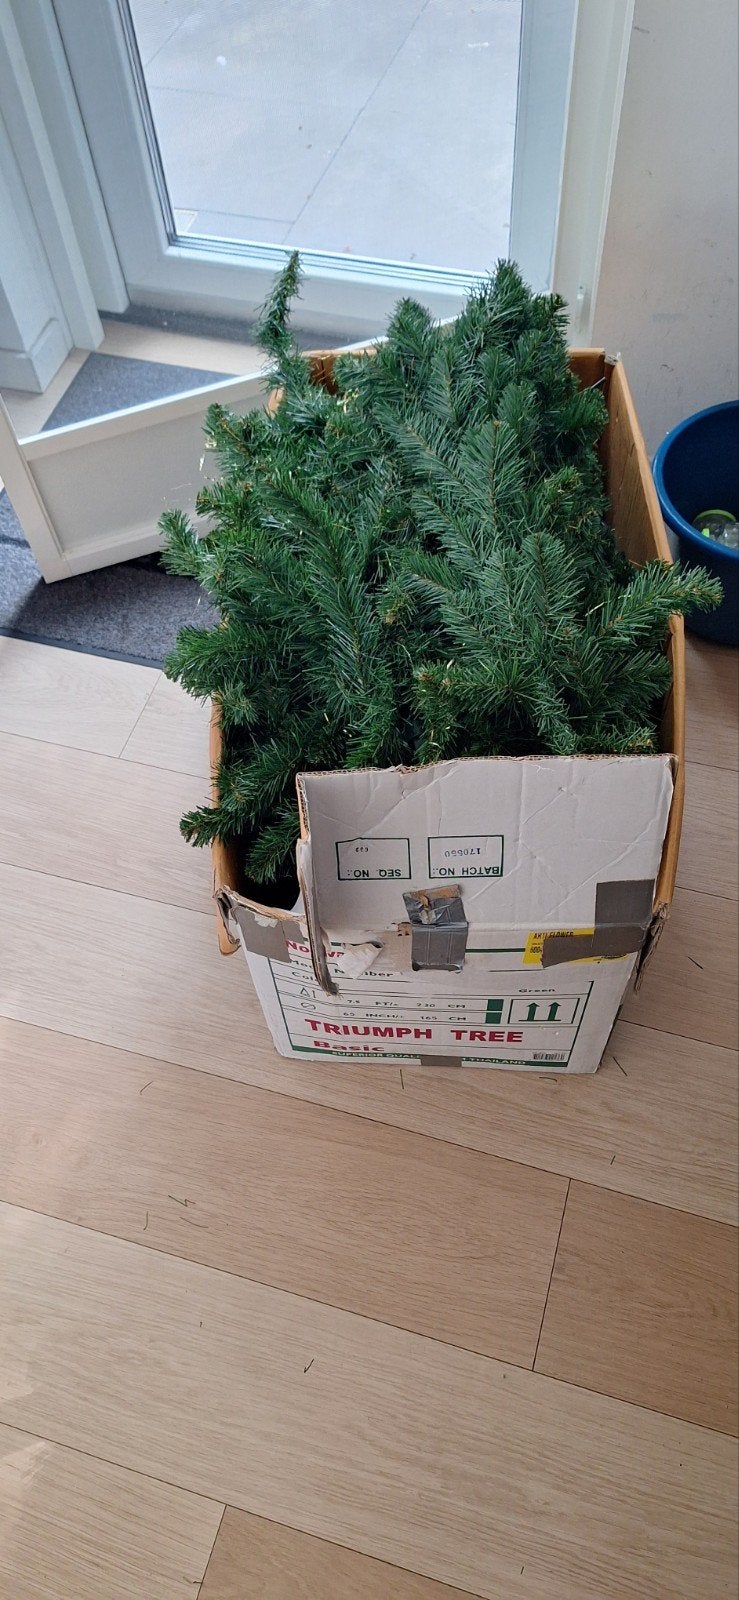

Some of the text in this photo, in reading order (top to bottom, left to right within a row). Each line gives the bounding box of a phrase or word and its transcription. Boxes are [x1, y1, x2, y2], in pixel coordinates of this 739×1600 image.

[461, 866, 500, 876] BATCH
[304, 1018, 524, 1043] TRIUMPH TREE
[313, 1040, 385, 1052] Basic
[469, 1057, 526, 1065] THAILAND
